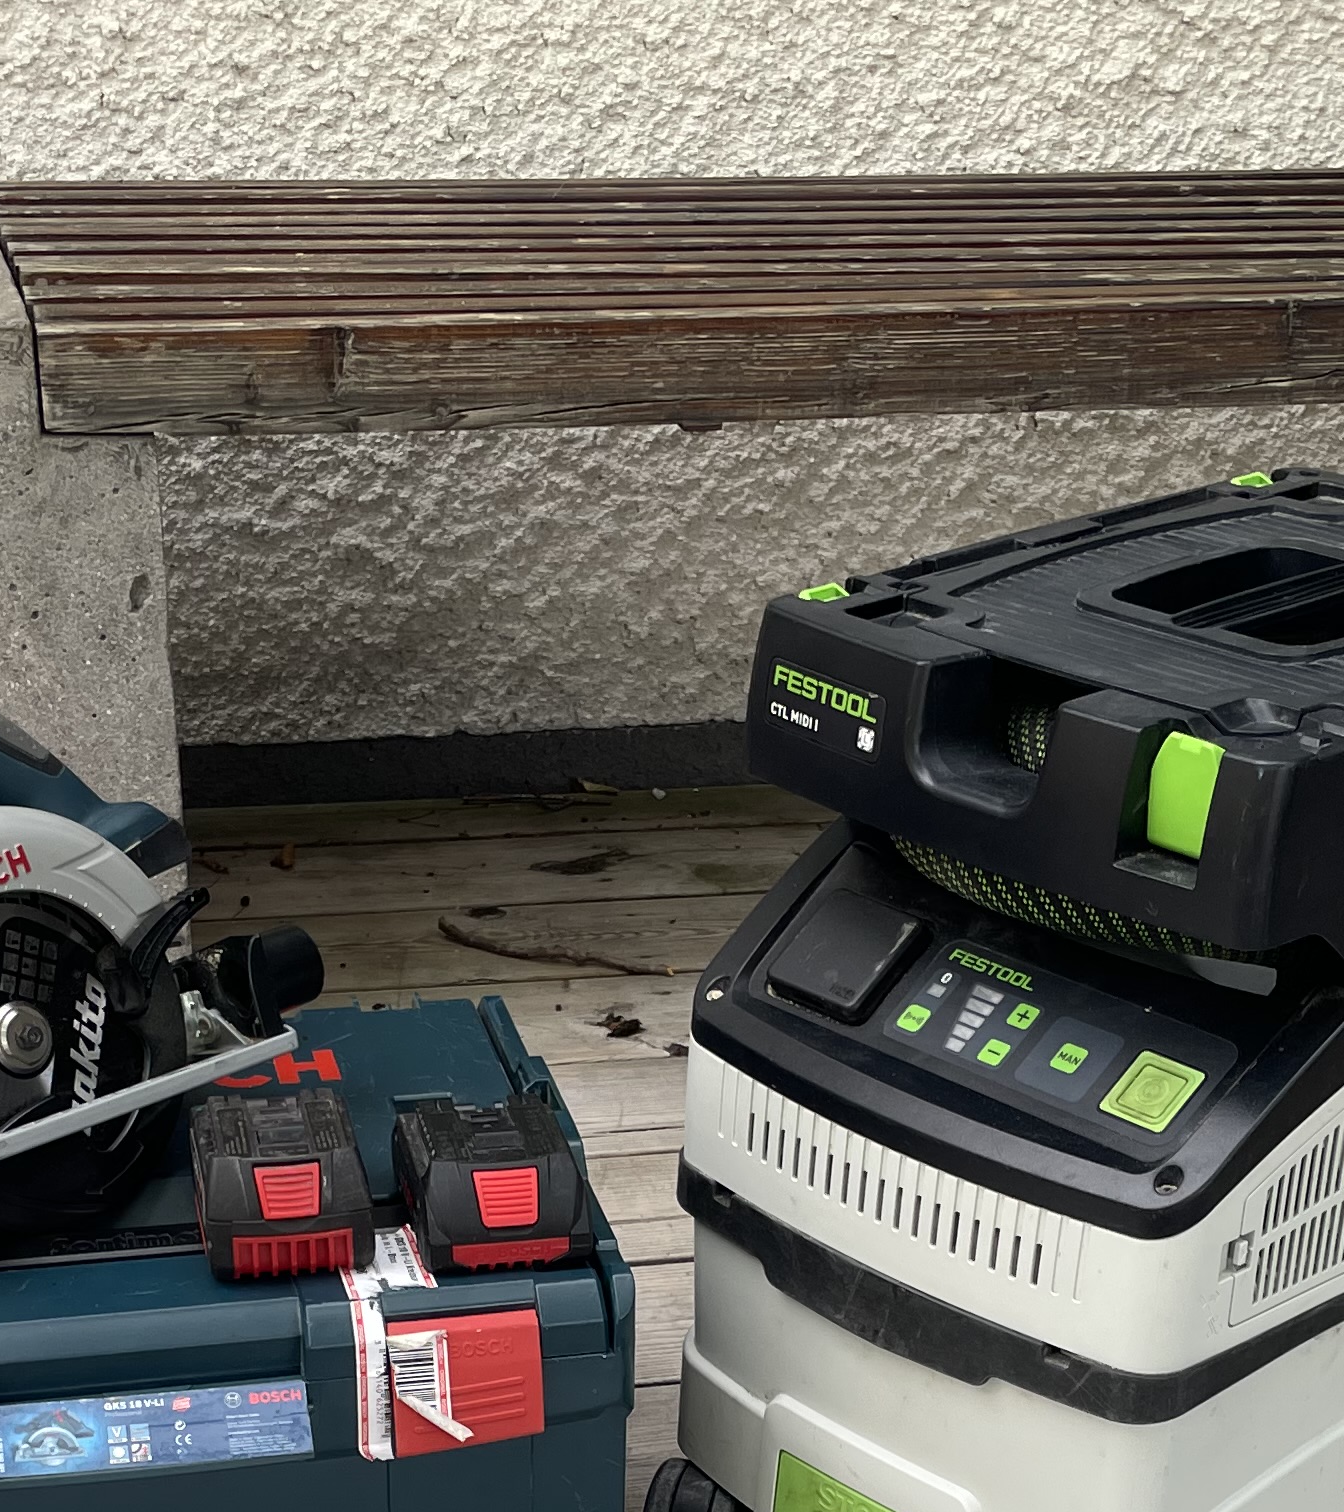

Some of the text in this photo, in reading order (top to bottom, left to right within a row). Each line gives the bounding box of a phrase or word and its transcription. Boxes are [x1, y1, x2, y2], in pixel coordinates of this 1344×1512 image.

[773, 664, 877, 724] FESTOOL
[770, 701, 789, 721] CTL
[790, 709, 813, 730] MIDI
[940, 972, 953, 985] 0
[948, 948, 1034, 992] FESTOOL
[69, 973, 107, 1136] akita
[1058, 1050, 1082, 1066] MAN
[451, 1338, 513, 1359] BOSCH
[249, 1389, 302, 1405] BOSCH
